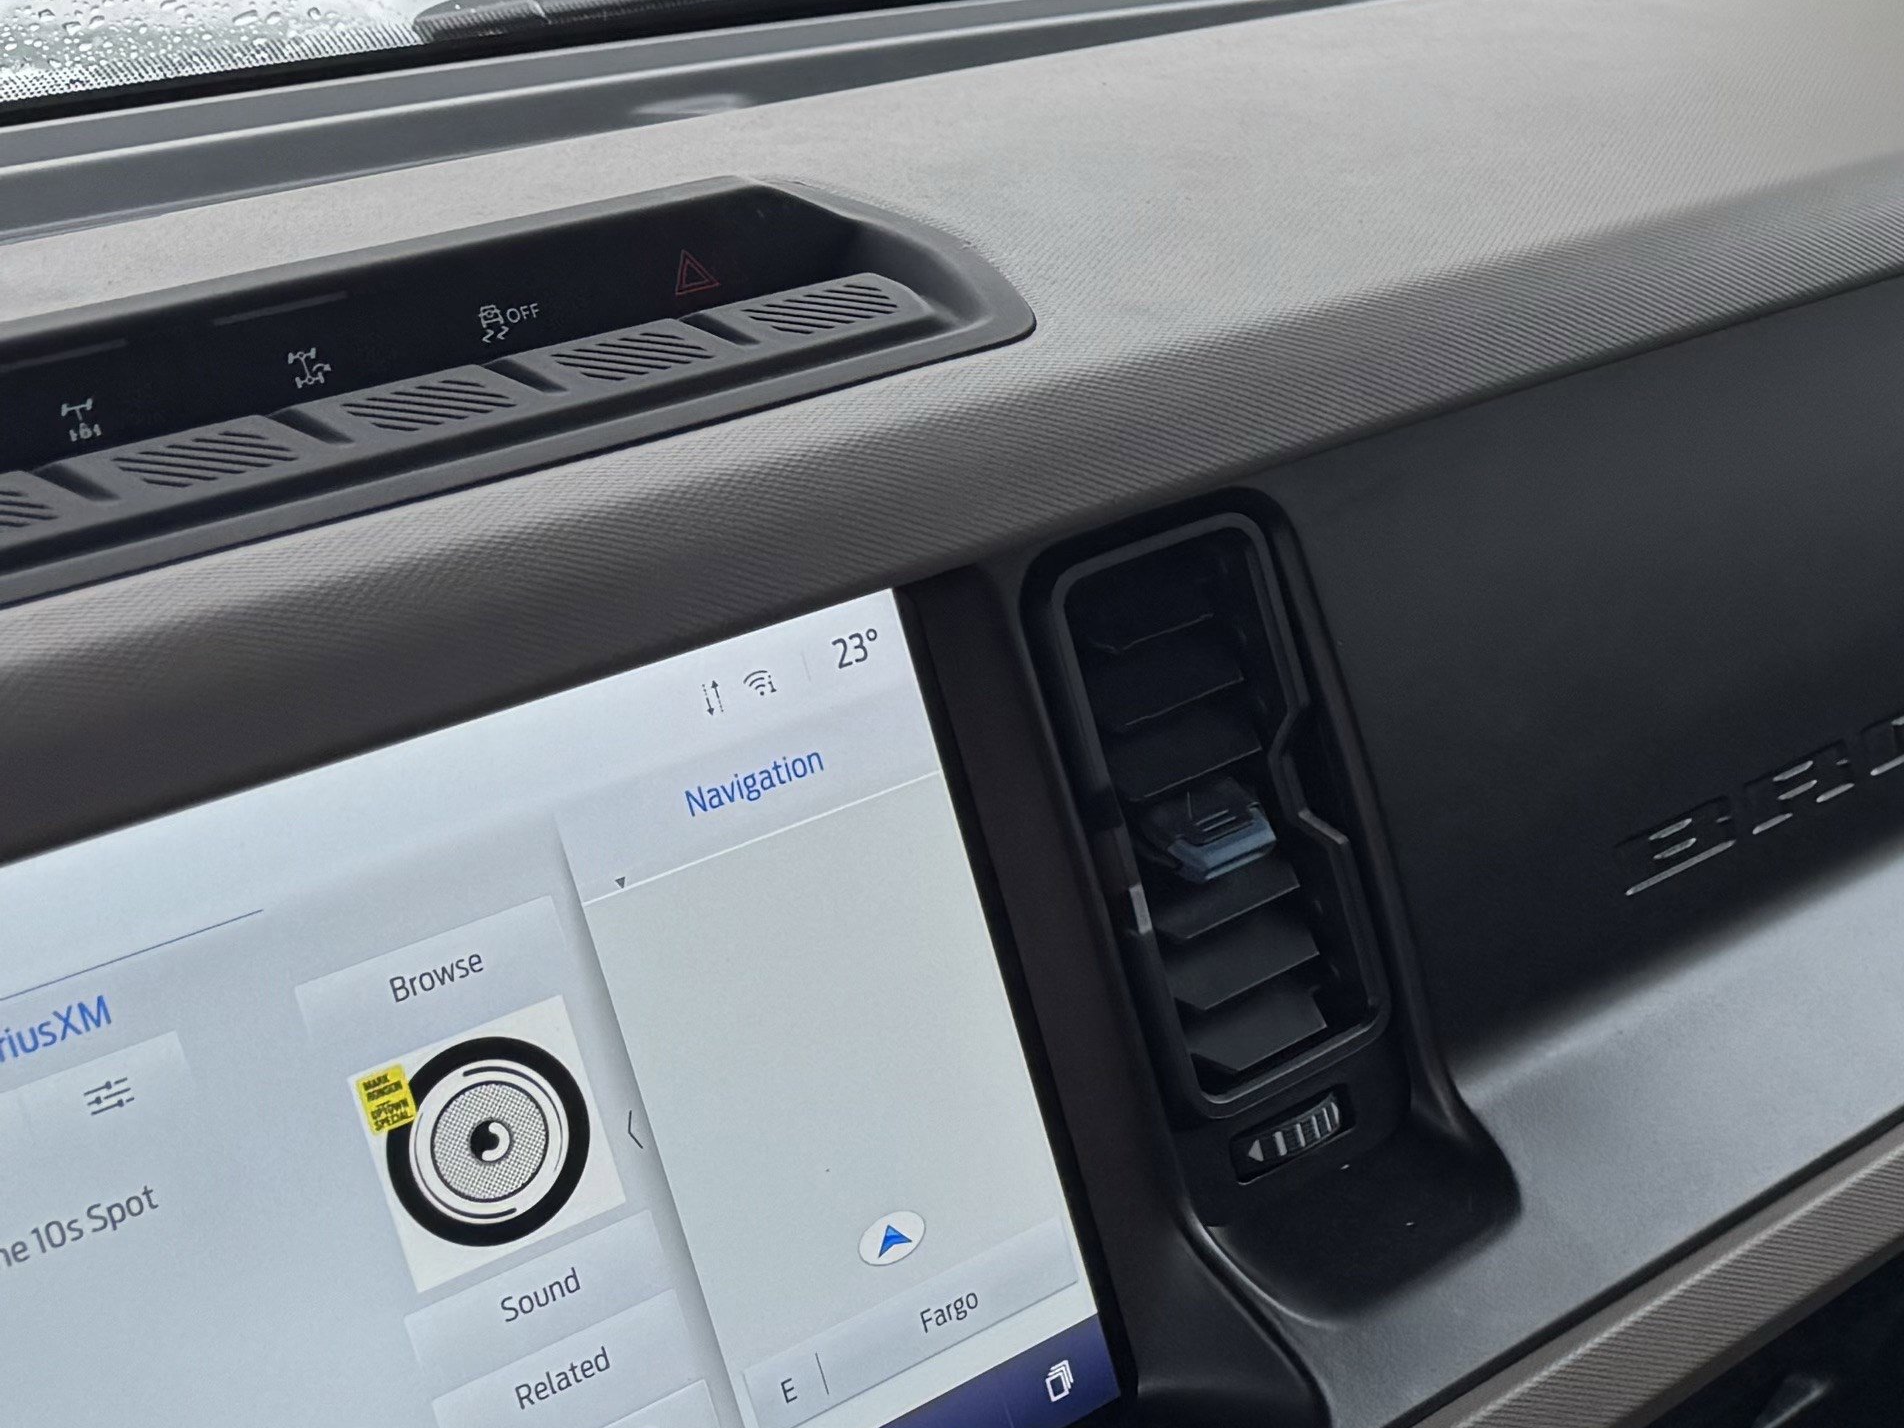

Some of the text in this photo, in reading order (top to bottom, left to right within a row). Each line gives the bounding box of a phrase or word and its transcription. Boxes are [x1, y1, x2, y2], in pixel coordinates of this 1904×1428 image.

[505, 302, 541, 324] OFF
[830, 627, 879, 670] 23°
[683, 748, 825, 818] Navigation
[388, 950, 485, 1003] Browse
[0, 994, 112, 1063] riusXM
[31, 1218, 84, 1254] 10s
[86, 1184, 160, 1233] Spot
[500, 1266, 582, 1323] Sound
[919, 1289, 980, 1335] Fargo
[515, 1345, 611, 1411] Related
[779, 1377, 799, 1405] E
